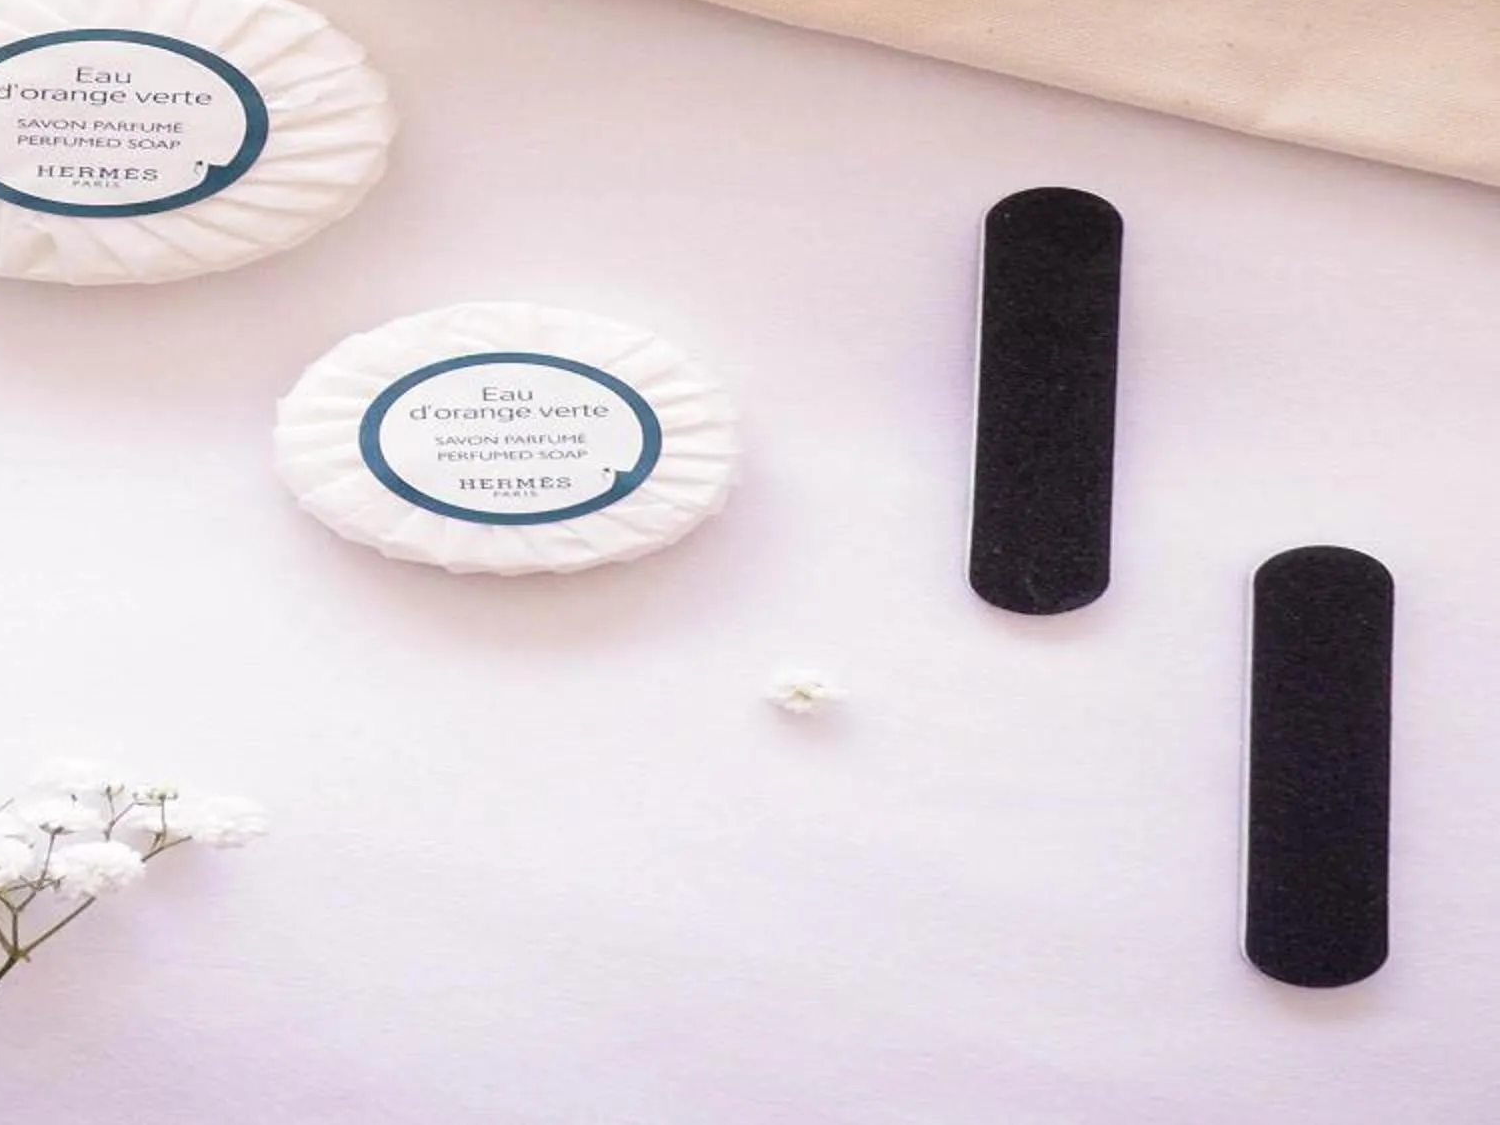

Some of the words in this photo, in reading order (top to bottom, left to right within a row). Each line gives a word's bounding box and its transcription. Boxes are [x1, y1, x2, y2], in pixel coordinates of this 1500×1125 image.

[76, 66, 133, 85] Eau
[135, 89, 213, 106] verte
[17, 118, 87, 131] SAVON
[17, 134, 122, 149] PERFUMED
[127, 137, 182, 151] SOAP
[481, 386, 534, 402] Eau
[409, 405, 532, 422] d'orange
[538, 404, 610, 420] verte
[435, 435, 500, 447] SAVON
[436, 450, 534, 462] PERFUMED
[538, 449, 589, 461] SOAP
